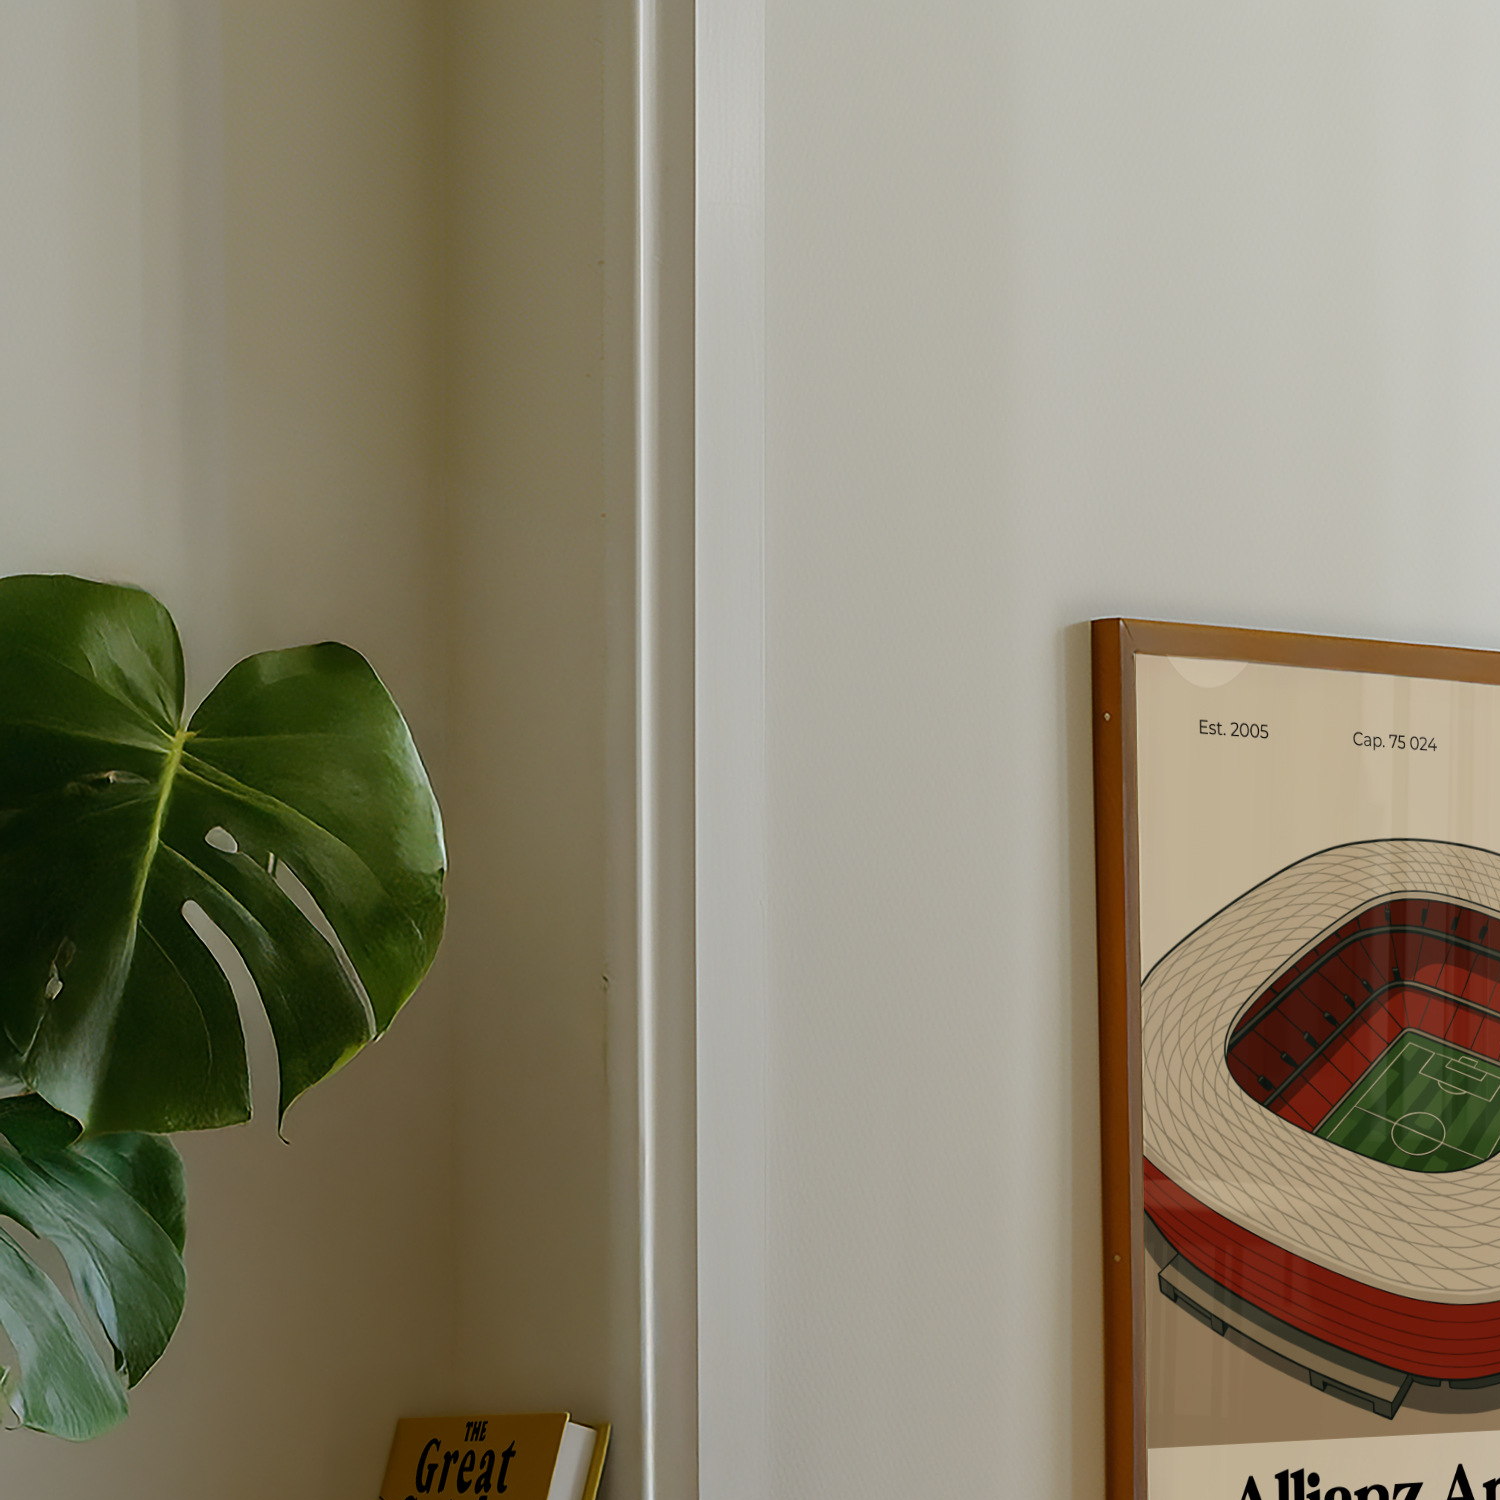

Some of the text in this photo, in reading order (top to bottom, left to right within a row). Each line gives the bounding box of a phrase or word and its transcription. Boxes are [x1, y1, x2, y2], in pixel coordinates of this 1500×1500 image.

[1198, 718, 1270, 740] Est. 2005
[1352, 731, 1438, 752] Cap. 75 024
[464, 1420, 489, 1443] THE
[414, 1437, 517, 1495] Great
